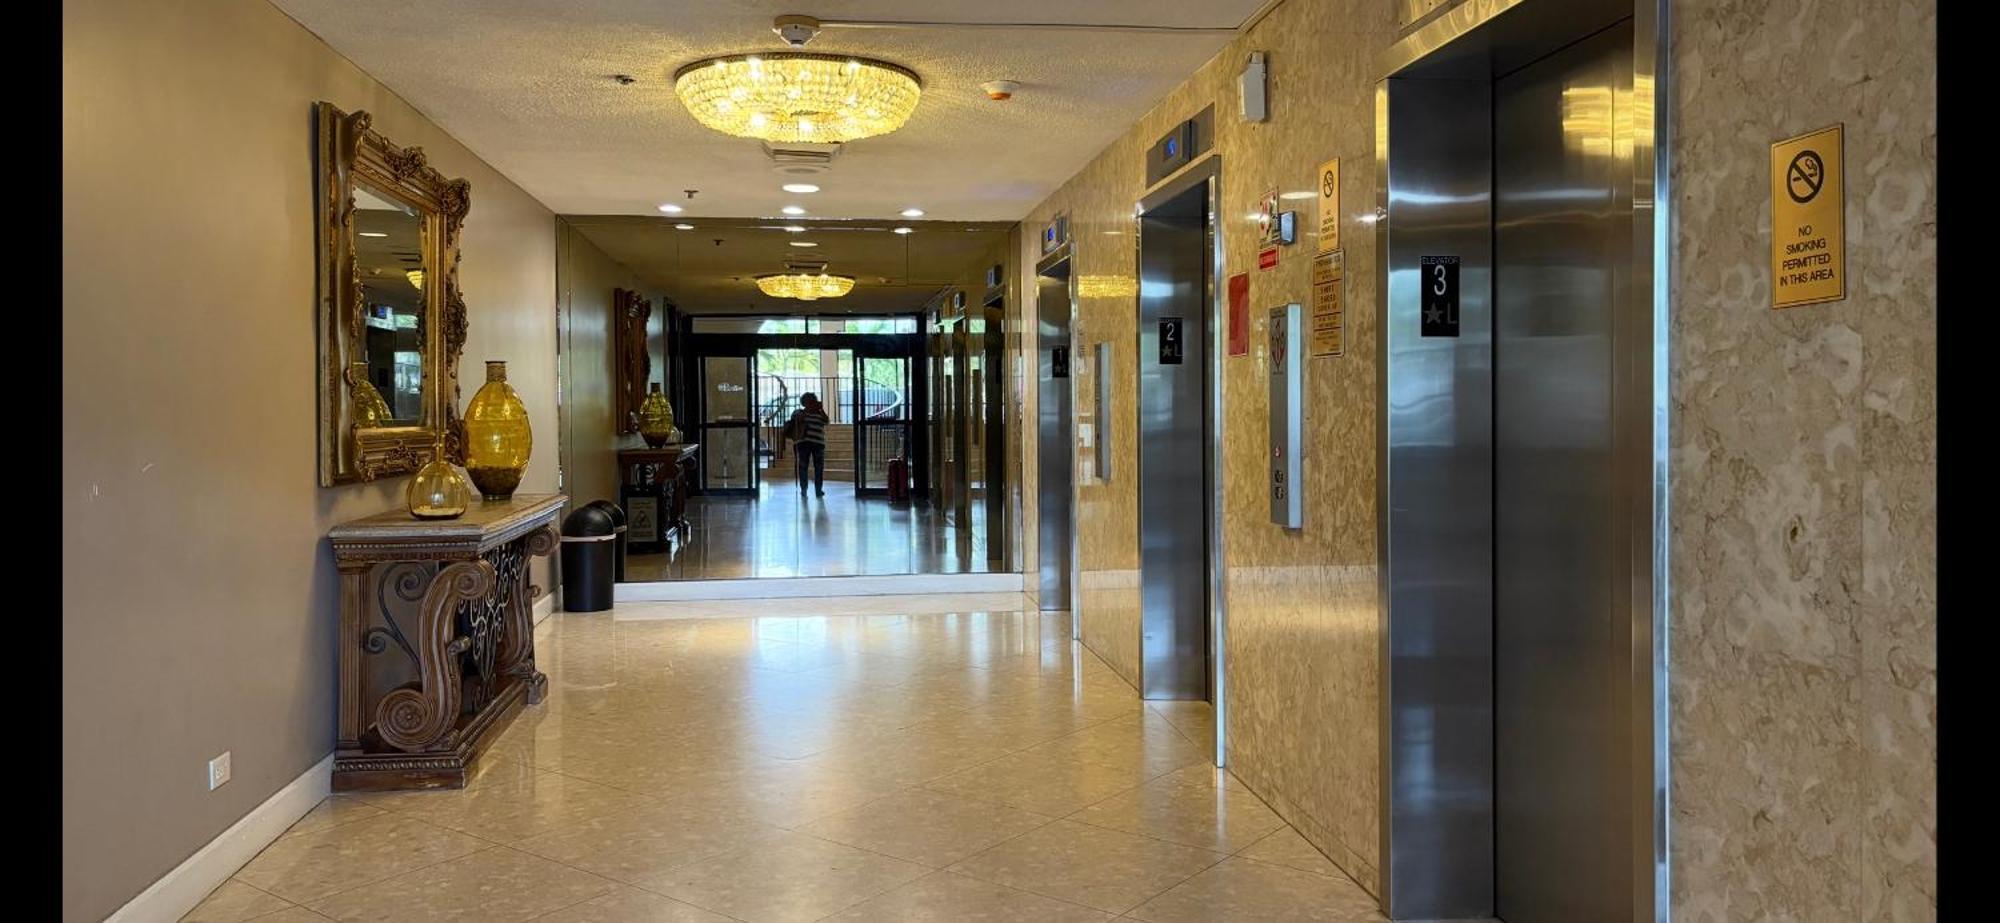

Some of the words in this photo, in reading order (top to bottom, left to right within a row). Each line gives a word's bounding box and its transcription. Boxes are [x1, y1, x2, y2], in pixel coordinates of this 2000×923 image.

[1798, 225, 1812, 237] NO
[1786, 238, 1826, 255] SMOKING
[1782, 253, 1831, 270] PERMITTED
[1434, 265, 1447, 295] 3
[1780, 276, 1788, 287] IN
[1790, 272, 1808, 284] THIS
[1809, 268, 1834, 281] AREA
[1447, 303, 1457, 324] L
[1167, 322, 1174, 341] 2
